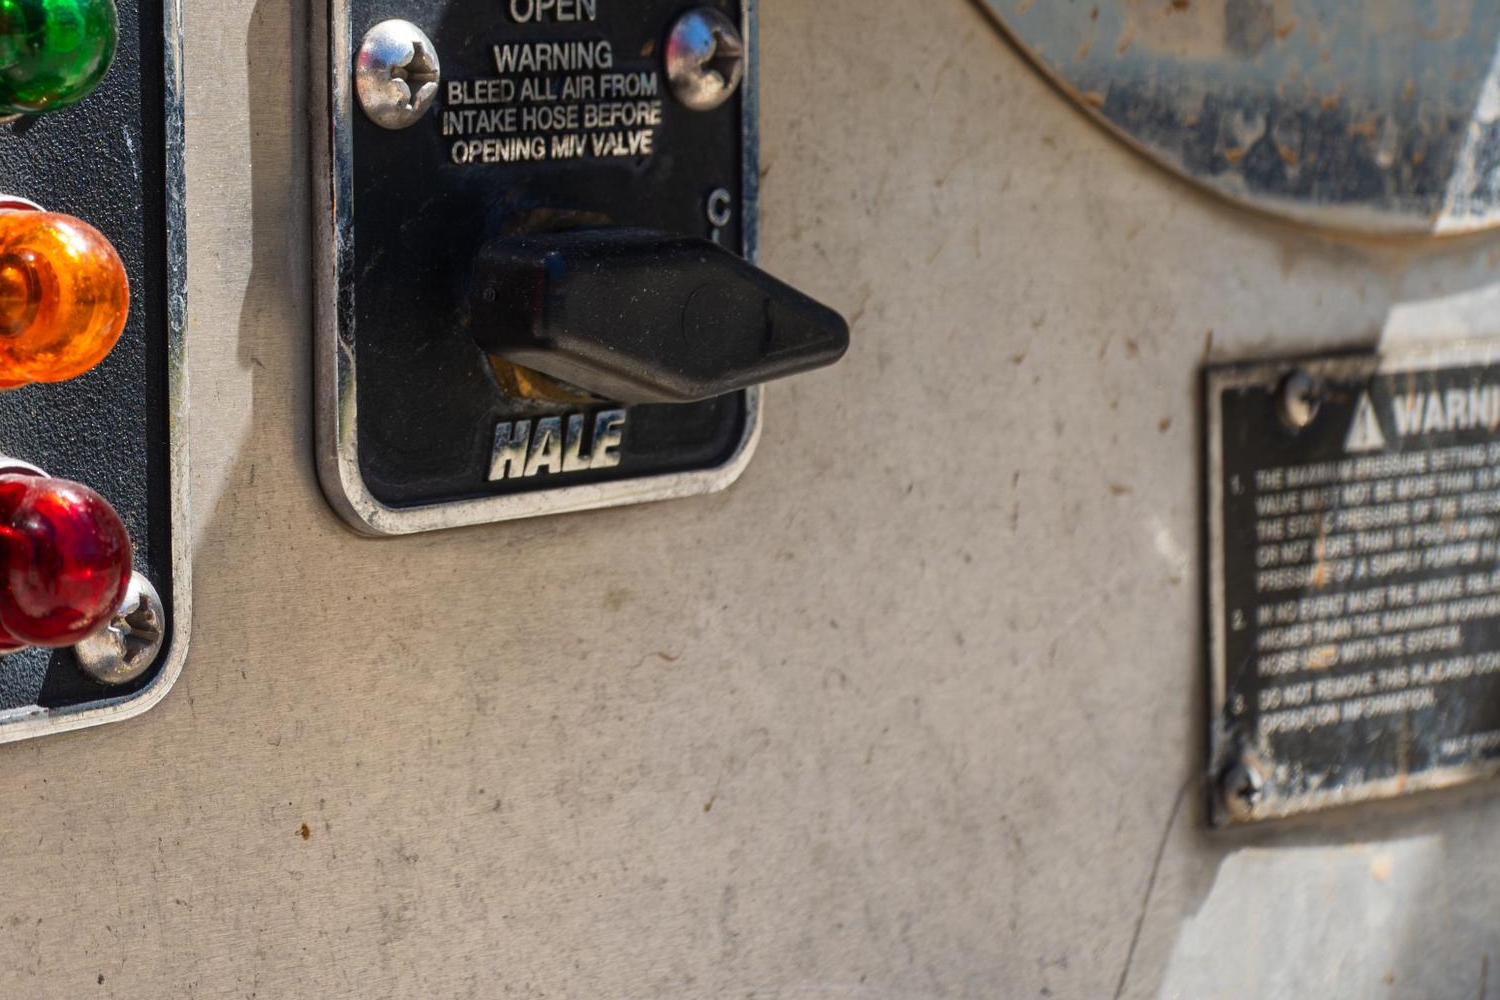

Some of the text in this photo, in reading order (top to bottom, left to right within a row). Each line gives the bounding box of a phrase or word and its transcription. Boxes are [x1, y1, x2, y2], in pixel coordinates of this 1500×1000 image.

[493, 41, 614, 74] WARNING
[448, 72, 658, 105] BLEED ALL AIR FROM
[442, 101, 662, 136] INTAKE HOSE BEFORE
[451, 136, 546, 165] OPENING
[592, 130, 654, 159] VALVE
[487, 408, 627, 483] HALE
[1256, 467, 1283, 489] THE
[1355, 452, 1426, 480] PRESSURE
[1430, 443, 1485, 472] SETTING
[1256, 491, 1299, 515] VALVE
[1342, 482, 1371, 506] NOT
[1375, 480, 1394, 502] BE
[1397, 475, 1436, 500] MORE
[1439, 470, 1472, 495] THAN
[1256, 517, 1283, 539] THE
[1338, 501, 1408, 530] PRESSURE
[1413, 498, 1430, 521] OF
[1256, 543, 1278, 566] OR
[1281, 539, 1308, 564] NOT
[1356, 528, 1393, 555] THAN
[1335, 559, 1352, 582] OF
[1356, 556, 1367, 579] A
[1370, 549, 1421, 577] SUPPLY
[1276, 600, 1297, 623] NO
[1300, 594, 1345, 620] EVENT
[1348, 588, 1385, 615] MUST
[1388, 584, 1414, 609] THE
[1257, 624, 1311, 651] HIGHER
[1313, 618, 1351, 644] THAN
[1353, 614, 1379, 638] THE
[1341, 638, 1376, 664] WITH
[1378, 634, 1403, 658] THE
[1283, 682, 1311, 706] NOT
[1315, 672, 1375, 701] REMOVE
[1378, 666, 1409, 691] THIS
